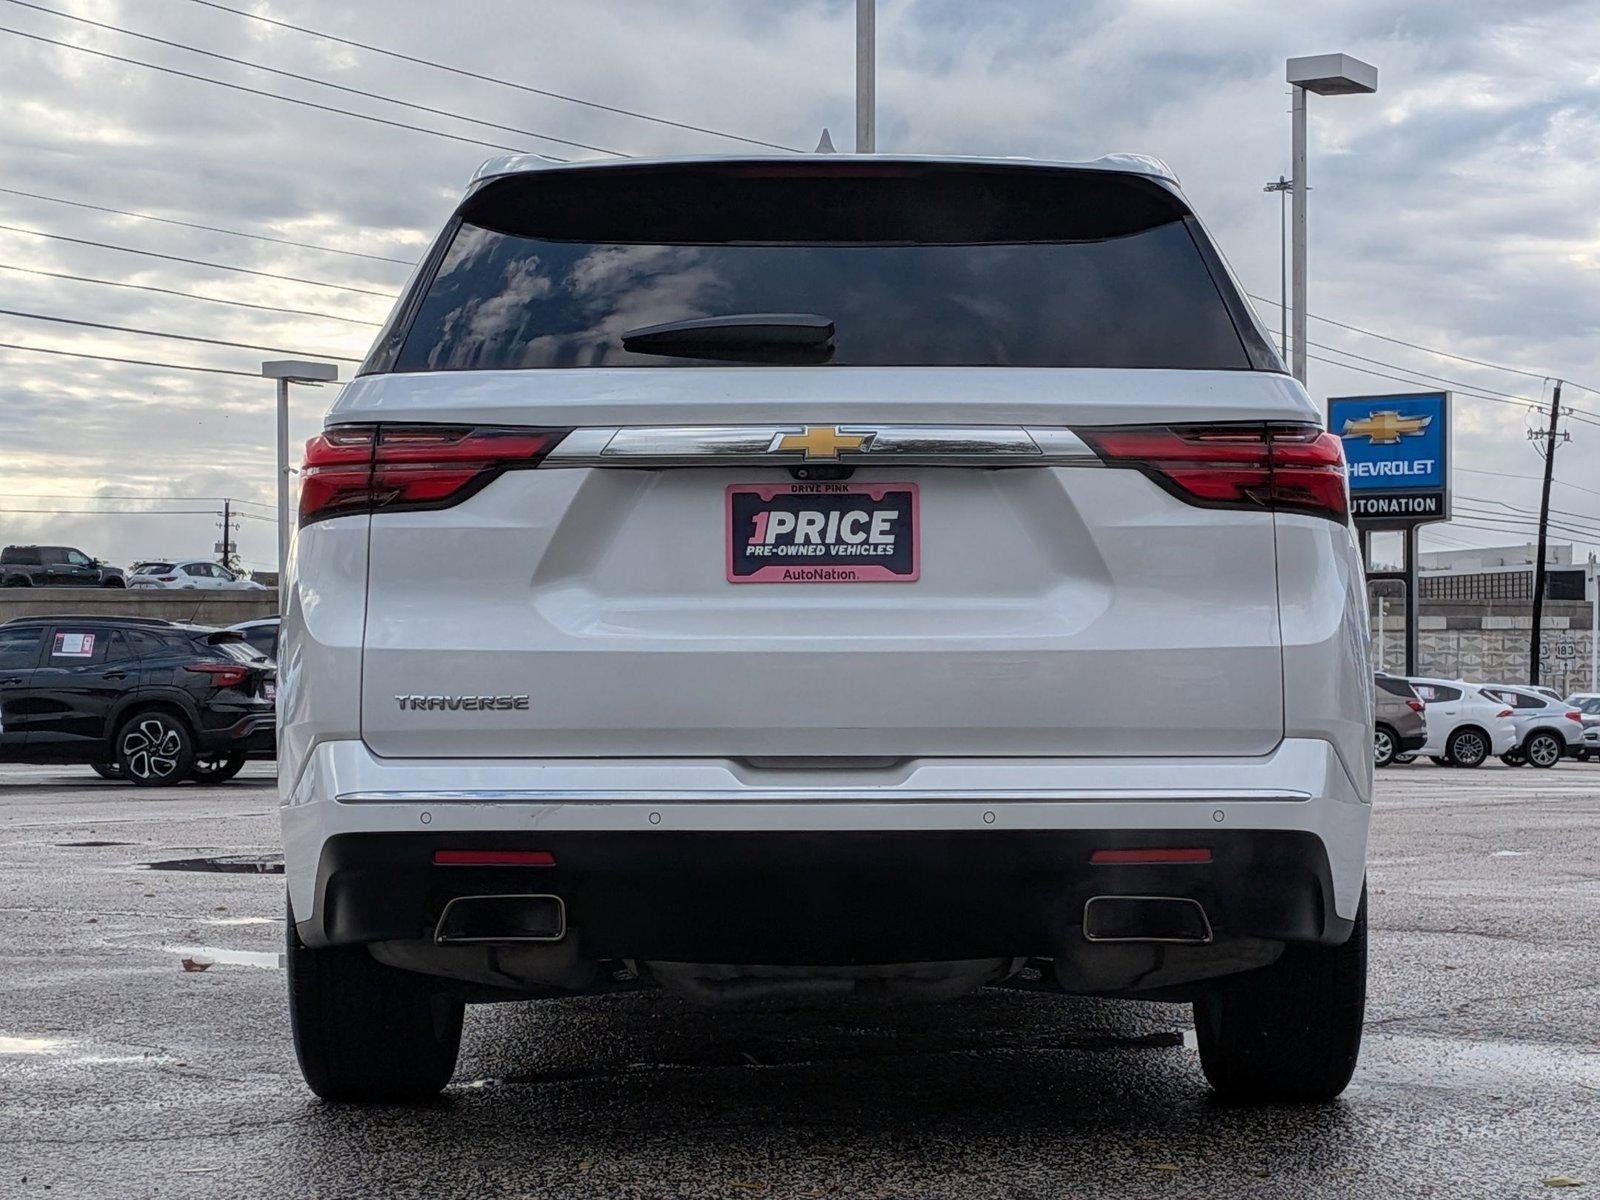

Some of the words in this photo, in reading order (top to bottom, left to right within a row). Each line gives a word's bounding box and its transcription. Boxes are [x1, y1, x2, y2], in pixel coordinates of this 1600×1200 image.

[1347, 459, 1435, 477] HEVROLET
[791, 484, 821, 493] DRIVE
[824, 484, 849, 493] PINK
[1349, 497, 1436, 513] UTONATION
[746, 545, 825, 556] PRE-OWNED
[830, 545, 895, 555] VEHICLES
[1557, 645, 1574, 656] 183
[395, 694, 530, 711] TRAVERSE
